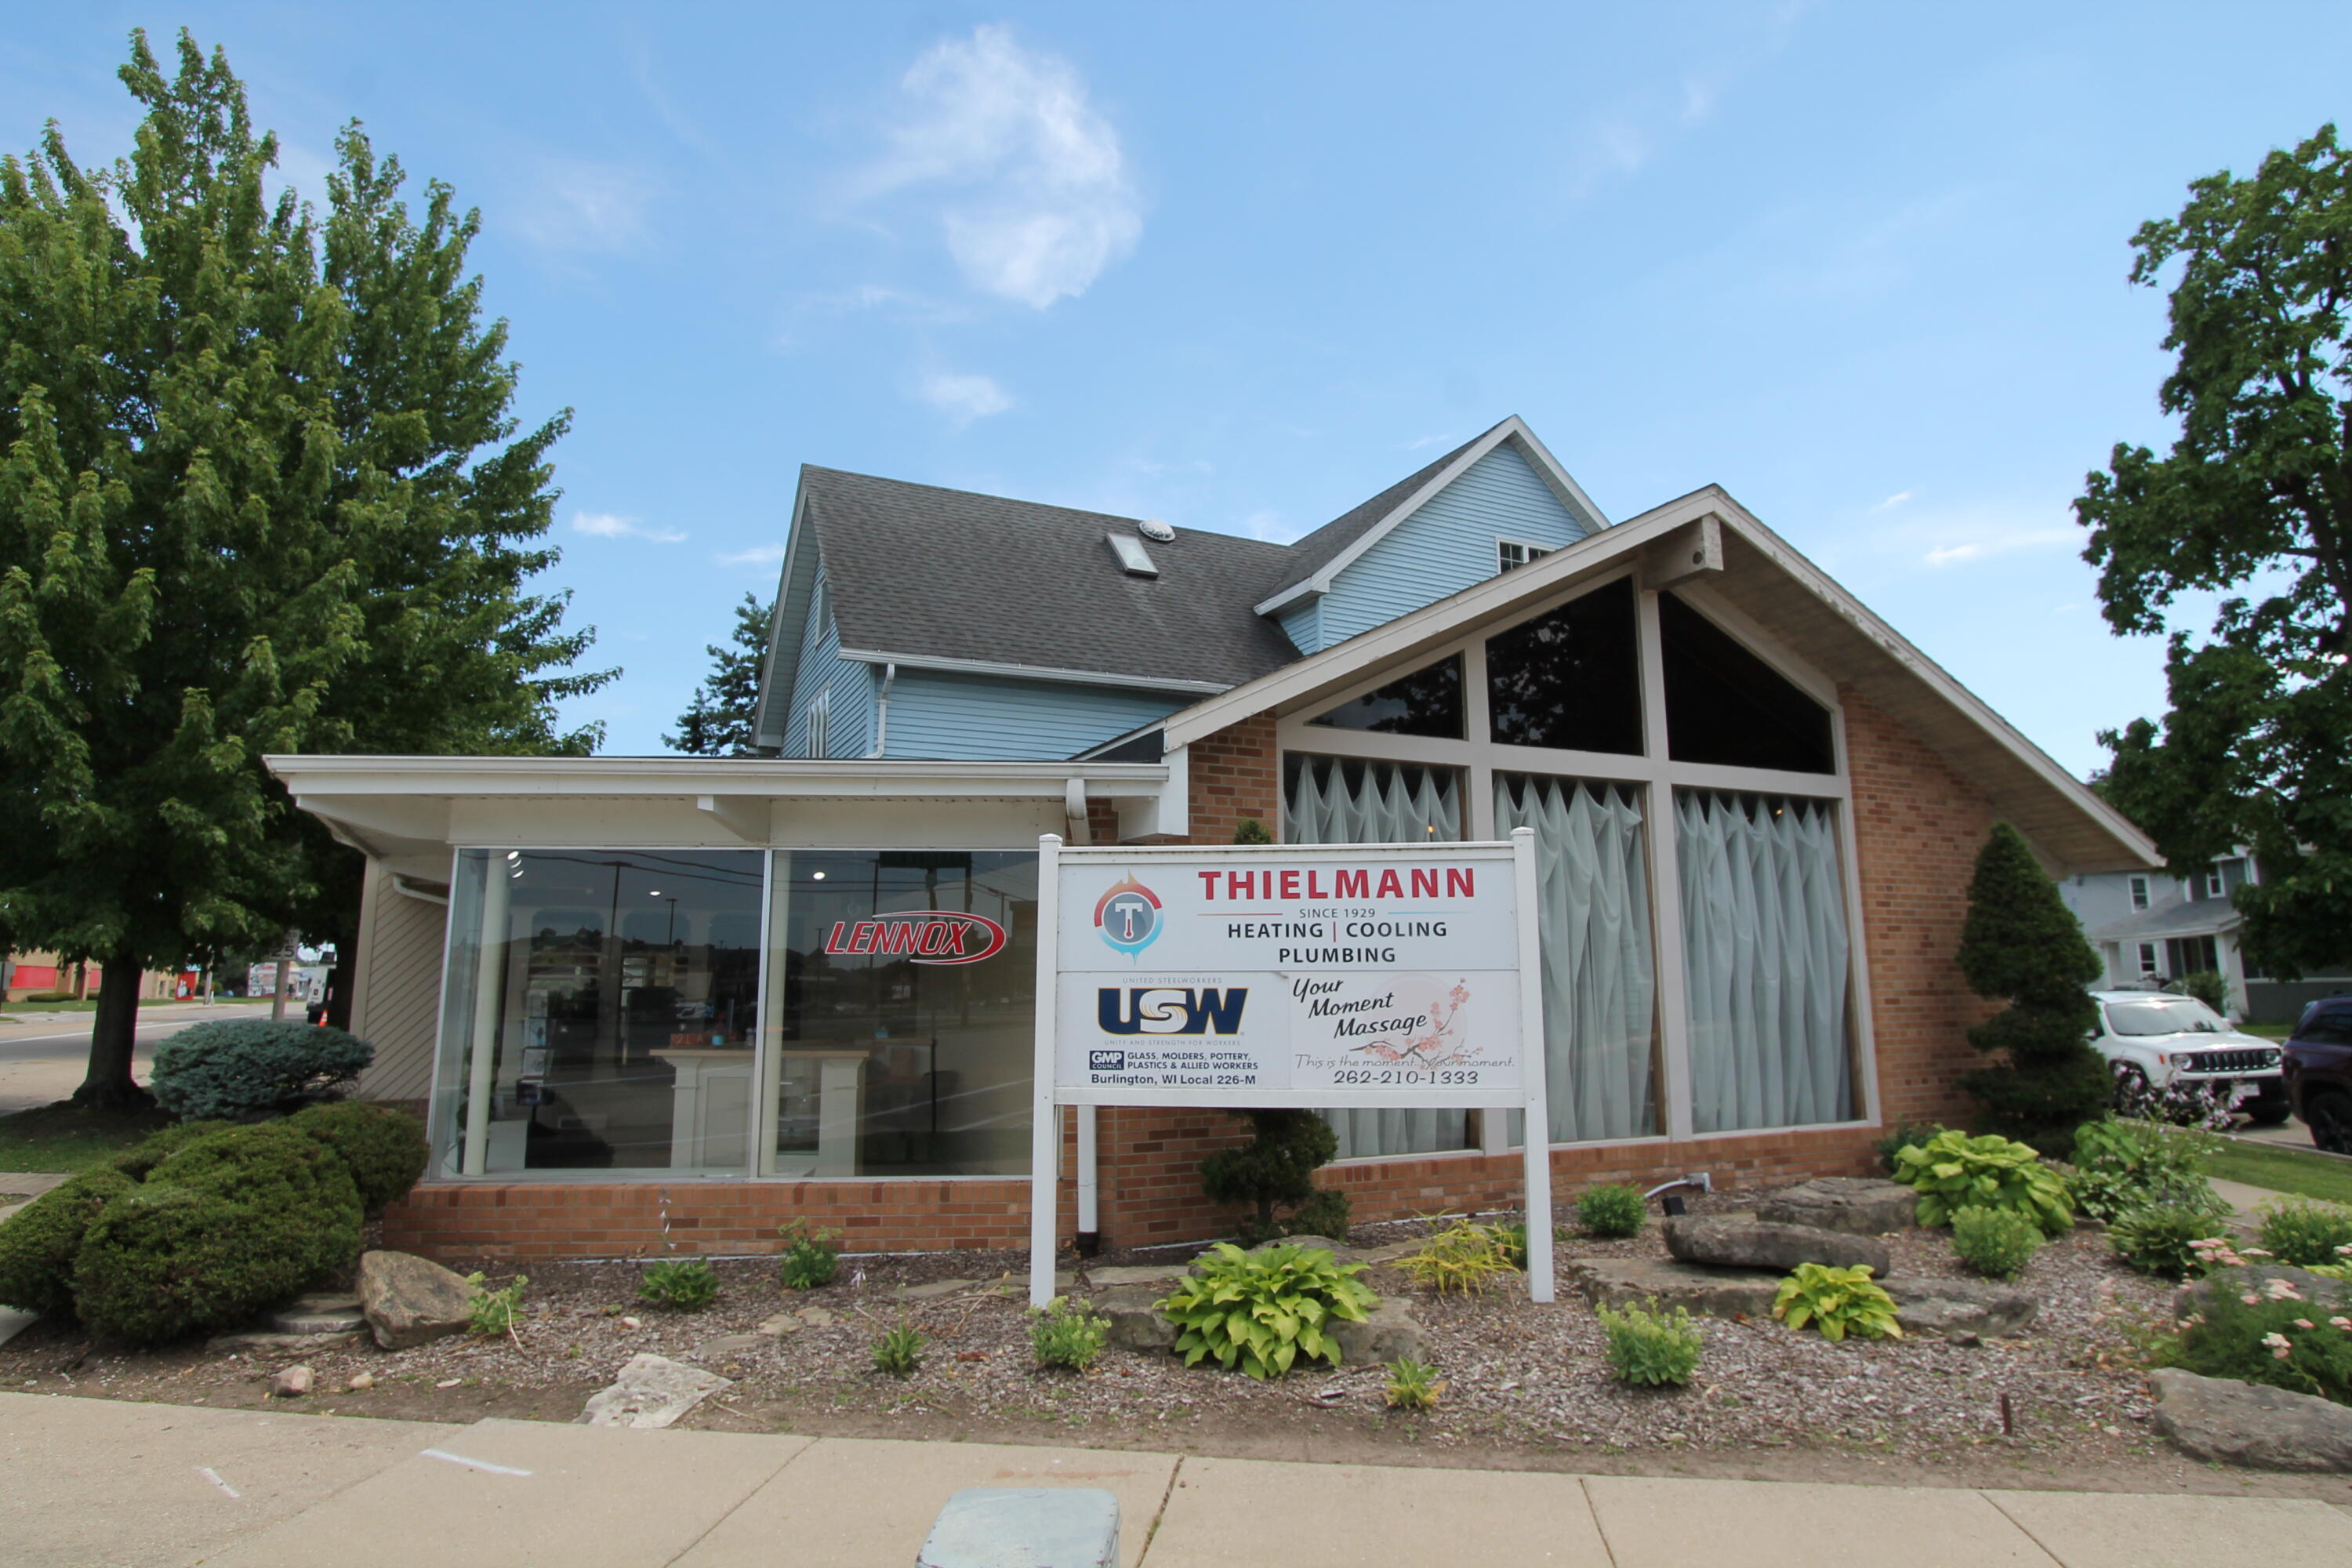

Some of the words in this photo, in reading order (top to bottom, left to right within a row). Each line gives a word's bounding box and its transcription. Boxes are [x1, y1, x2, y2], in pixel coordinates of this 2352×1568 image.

[1198, 868, 1475, 900] THIELMANN
[1299, 909, 1339, 918] SINCE
[1344, 908, 1376, 918] 1929
[825, 921, 973, 955] LENNOX
[1228, 923, 1323, 938] HEATING
[1346, 921, 1447, 938] COOLING
[271, 945, 295, 957] 25
[1279, 947, 1396, 964] PLUMBING
[1293, 978, 1344, 1004] Your
[1098, 987, 1249, 1036] USW
[1308, 992, 1395, 1018] Moment
[1334, 1014, 1428, 1039] Massage
[1091, 1051, 1122, 1063] GMP
[1127, 1052, 1160, 1061] GLASS,
[1162, 1052, 1207, 1061] MOLDERS,
[1210, 1052, 1251, 1061] POTTERY,
[1295, 1054, 1323, 1069] This
[1327, 1058, 1335, 1069] is
[1339, 1054, 1359, 1066] the
[1091, 1074, 1158, 1086] Burlington,
[1162, 1075, 1176, 1083] WI
[1180, 1075, 1212, 1084] Local
[1217, 1075, 1256, 1084] 226-M
[1333, 1069, 1479, 1084] 262-210-1333
